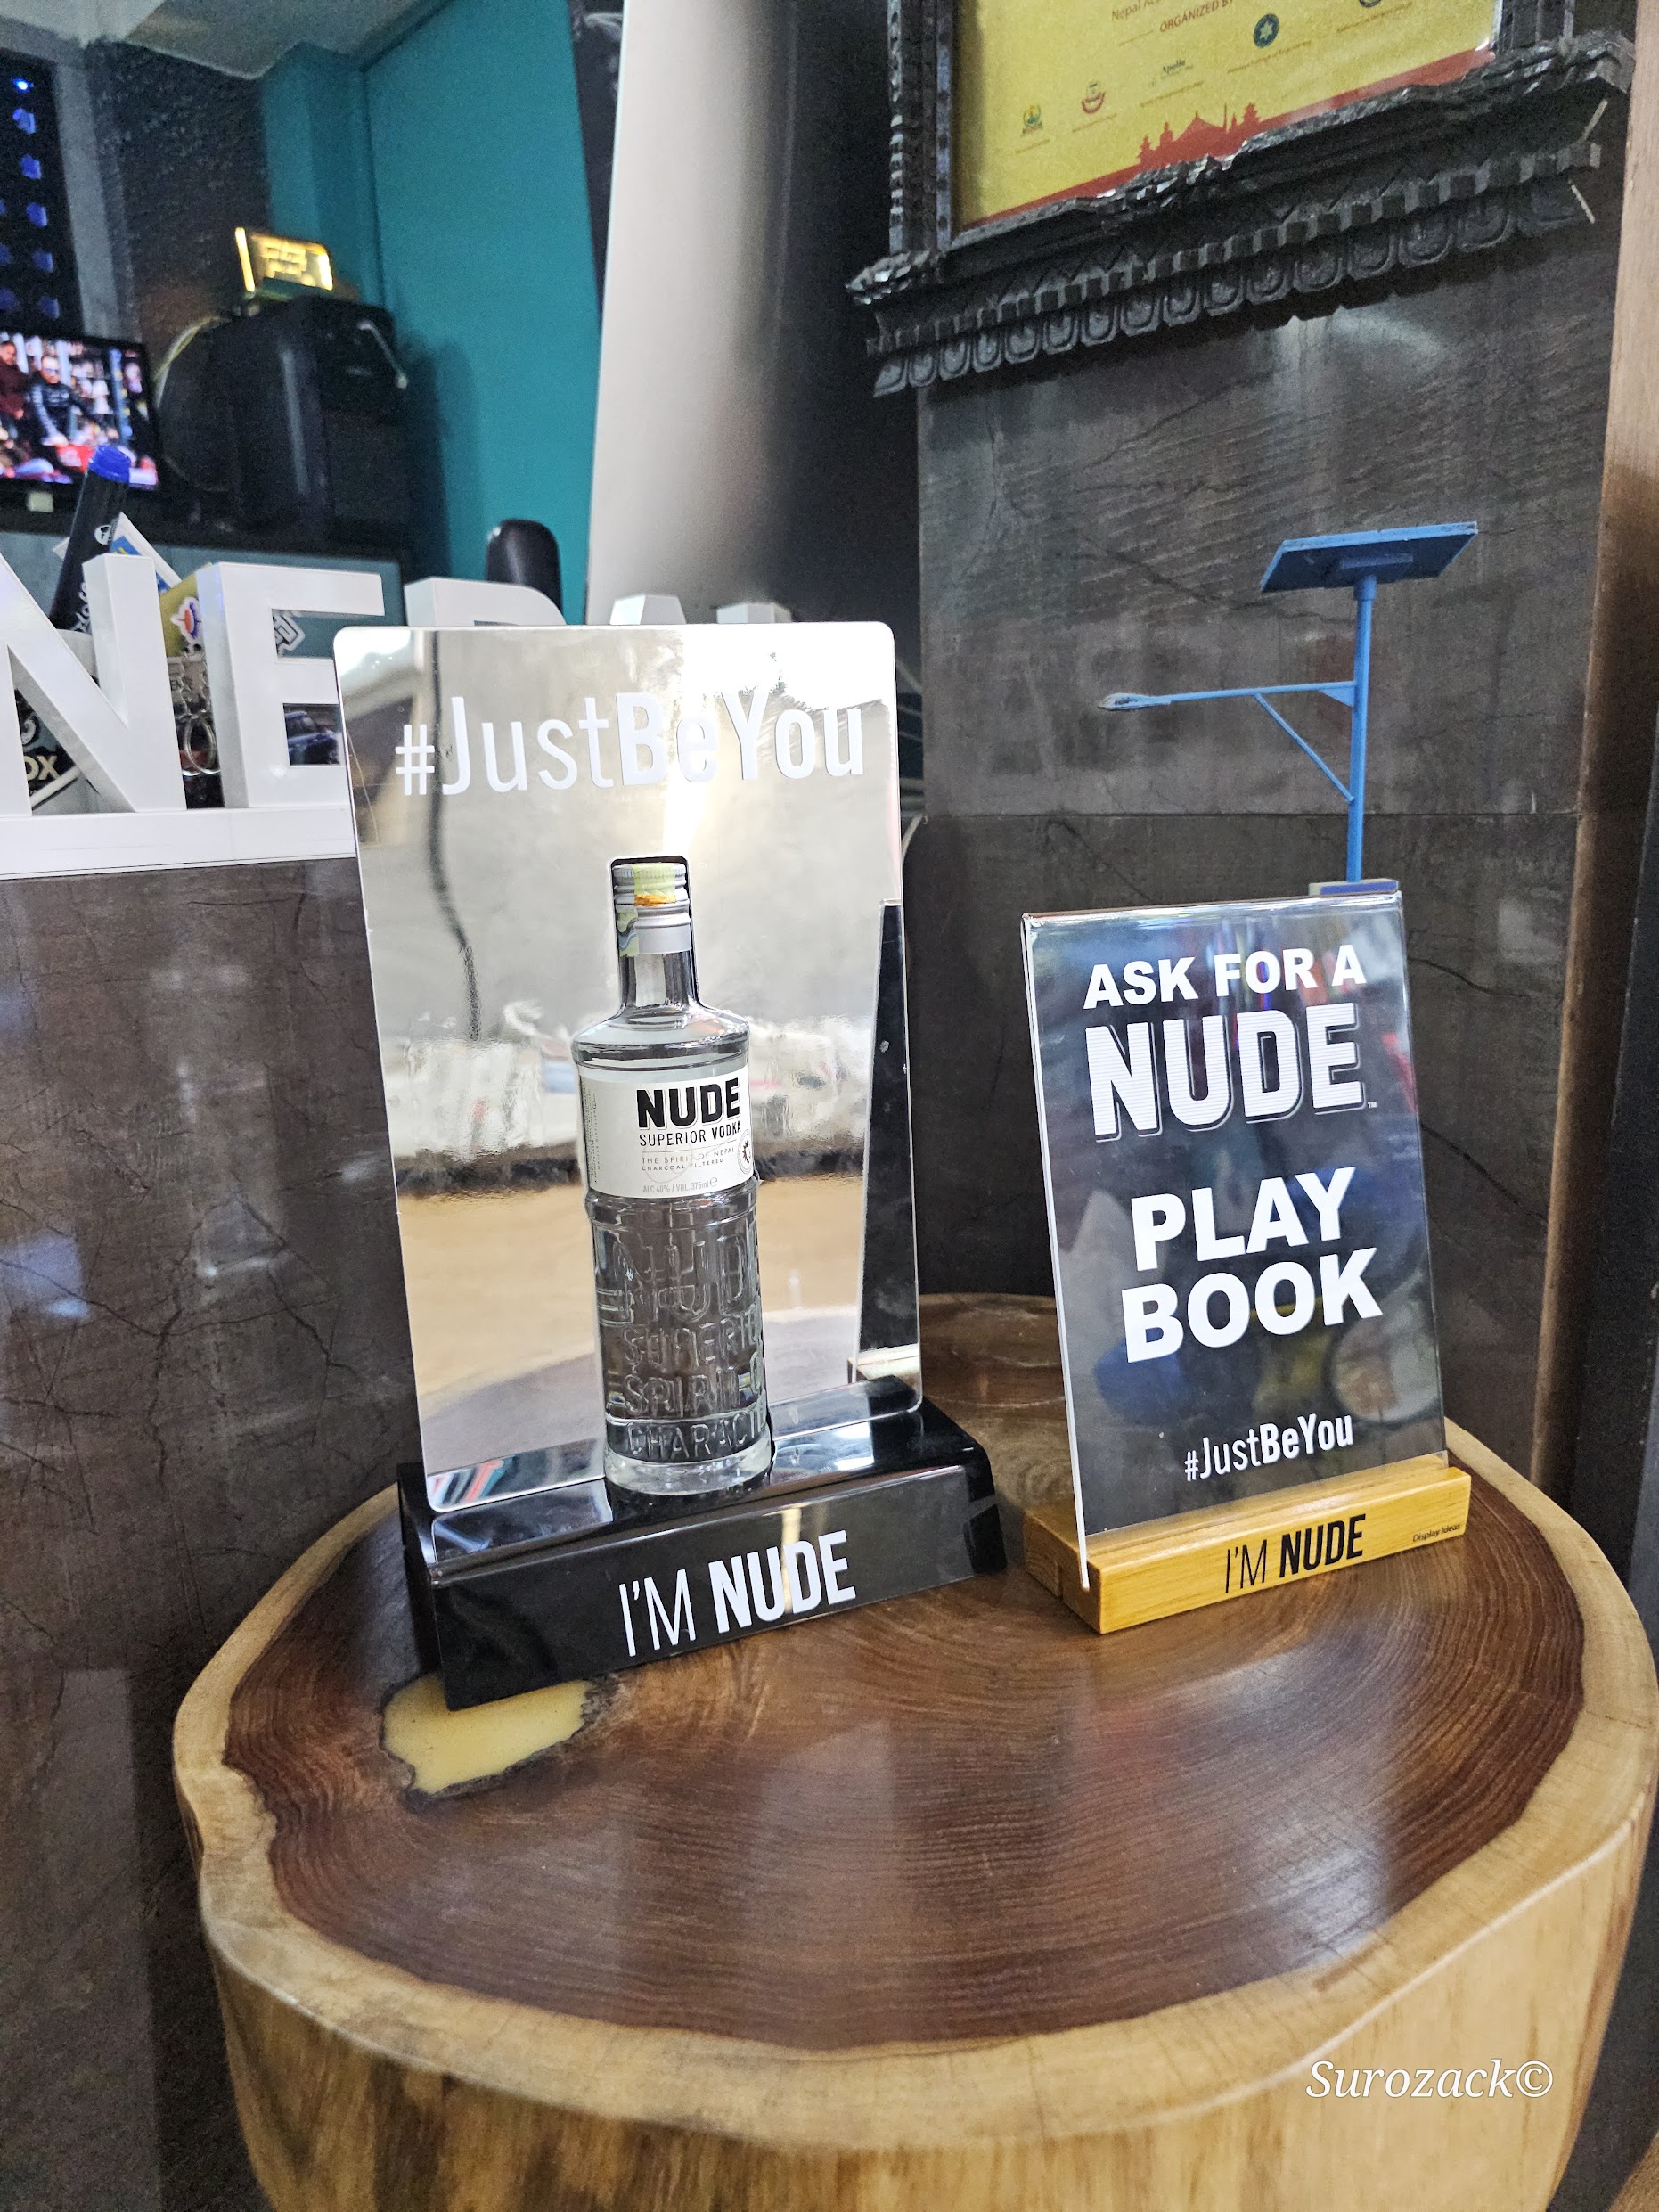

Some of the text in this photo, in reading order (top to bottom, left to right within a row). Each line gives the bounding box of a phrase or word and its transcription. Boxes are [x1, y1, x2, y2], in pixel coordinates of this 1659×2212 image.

[1159, 2, 1219, 32] ORGANIZED
[395, 690, 864, 795] #JustBeYou
[1083, 944, 1367, 1010] ASK FOR A
[636, 1077, 741, 1129] NUDE
[1084, 1002, 1366, 1143] NUDE
[639, 1120, 742, 1147] SUPERIOR VODKA
[665, 1154, 693, 1164] SPIRIT
[699, 1151, 709, 1160] OF
[714, 1147, 735, 1157] NEPAL
[690, 1159, 723, 1168] FILTERED
[642, 1185, 655, 1193] ALC
[657, 1184, 670, 1192] 40%
[1130, 1166, 1355, 1272] PLAY
[1121, 1247, 1383, 1364] BOOK
[1184, 1413, 1353, 1481] #JustBeYou
[1225, 1513, 1366, 1593] I'M NUDE
[1412, 1523, 1461, 1542] Display Ideas
[619, 1529, 856, 1657] I'M NUDE
